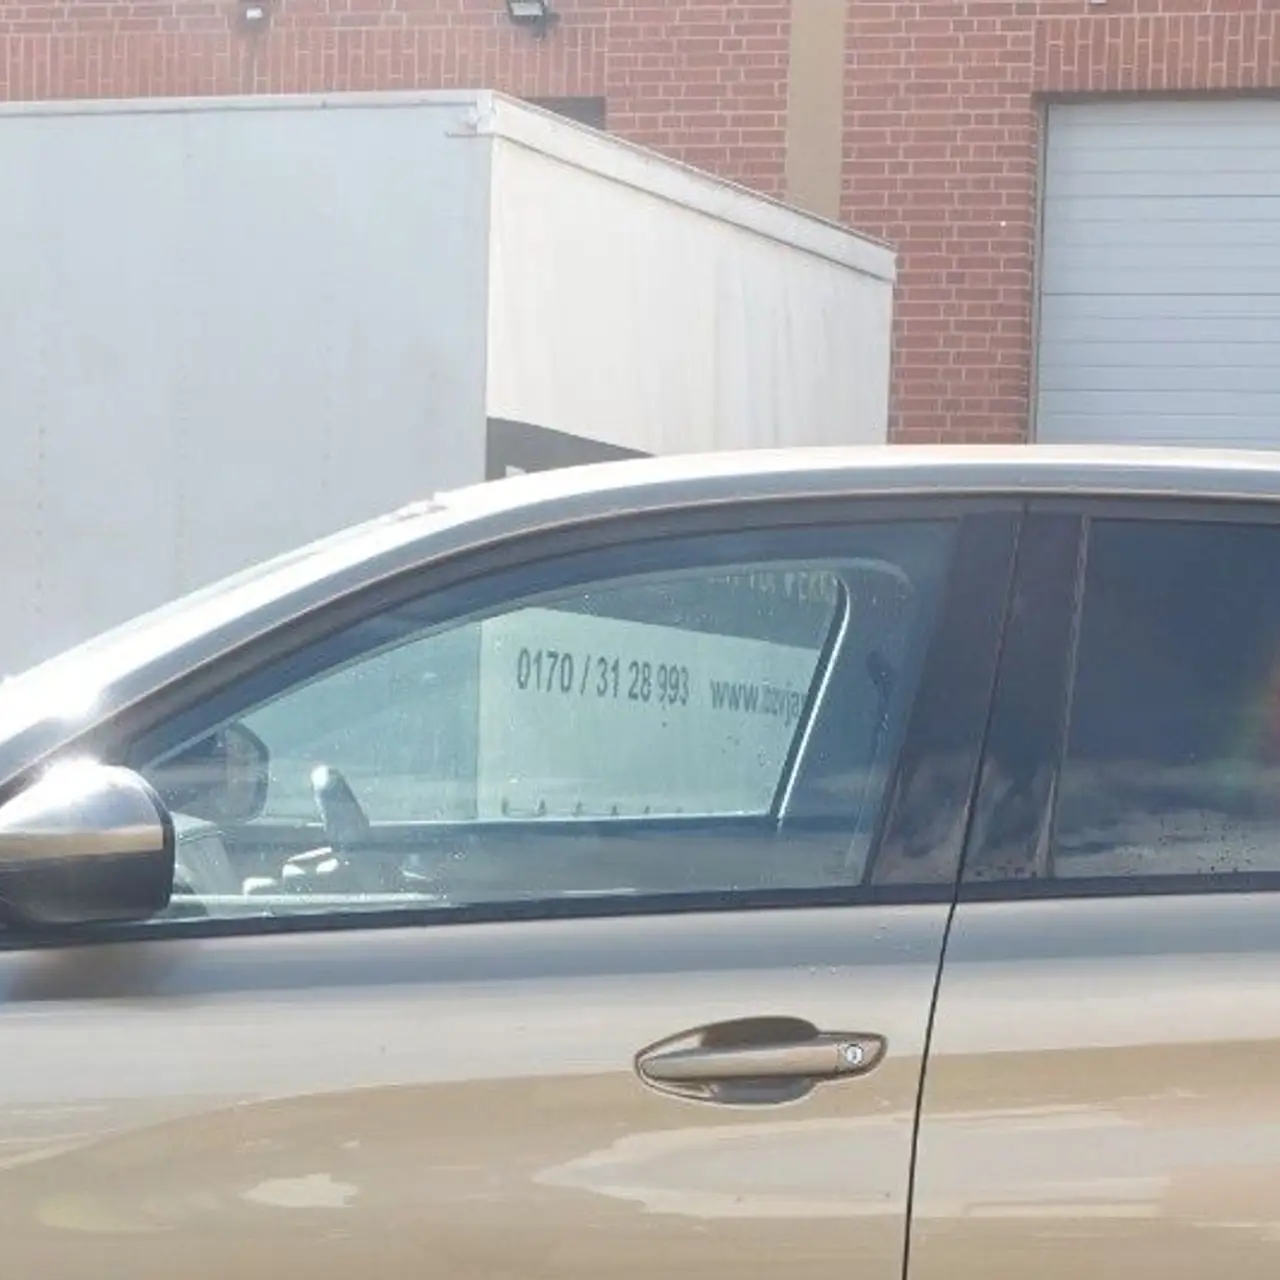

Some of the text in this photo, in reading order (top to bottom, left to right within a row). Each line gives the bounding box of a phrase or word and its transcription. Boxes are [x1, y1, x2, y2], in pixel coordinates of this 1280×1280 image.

[517, 648, 574, 693] 0170
[596, 656, 620, 699] 31
[628, 660, 653, 702] 28
[657, 664, 690, 707] 993
